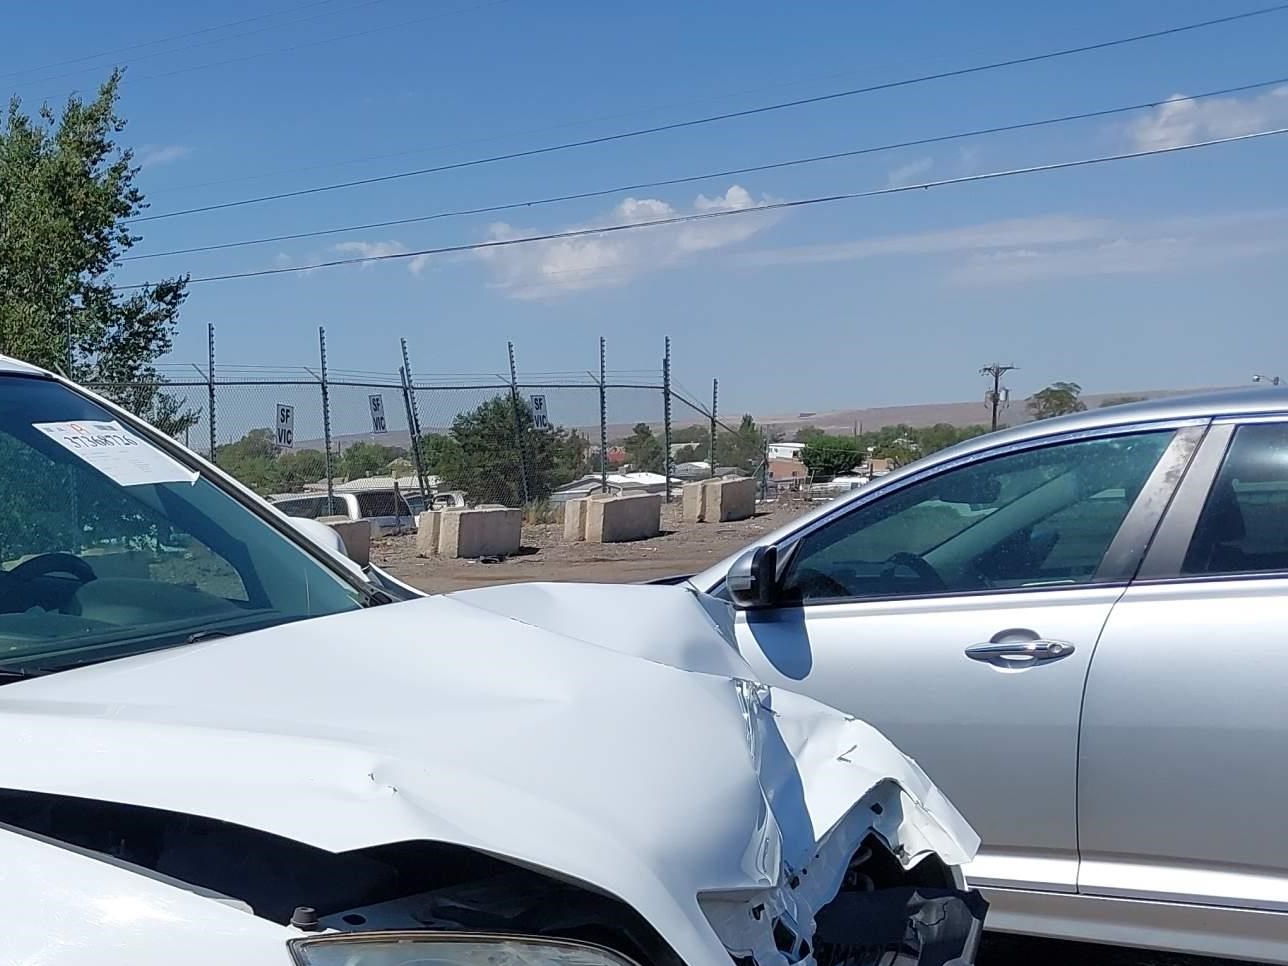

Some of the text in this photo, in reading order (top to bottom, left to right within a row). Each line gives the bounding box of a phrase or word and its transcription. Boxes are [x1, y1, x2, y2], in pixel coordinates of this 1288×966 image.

[372, 398, 380, 412] SF
[534, 398, 543, 410] SF
[280, 408, 290, 424] SF
[373, 416, 386, 431] VIC
[534, 415, 547, 428] VIC
[64, 434, 138, 449] 37368726
[277, 428, 292, 444] VIC
